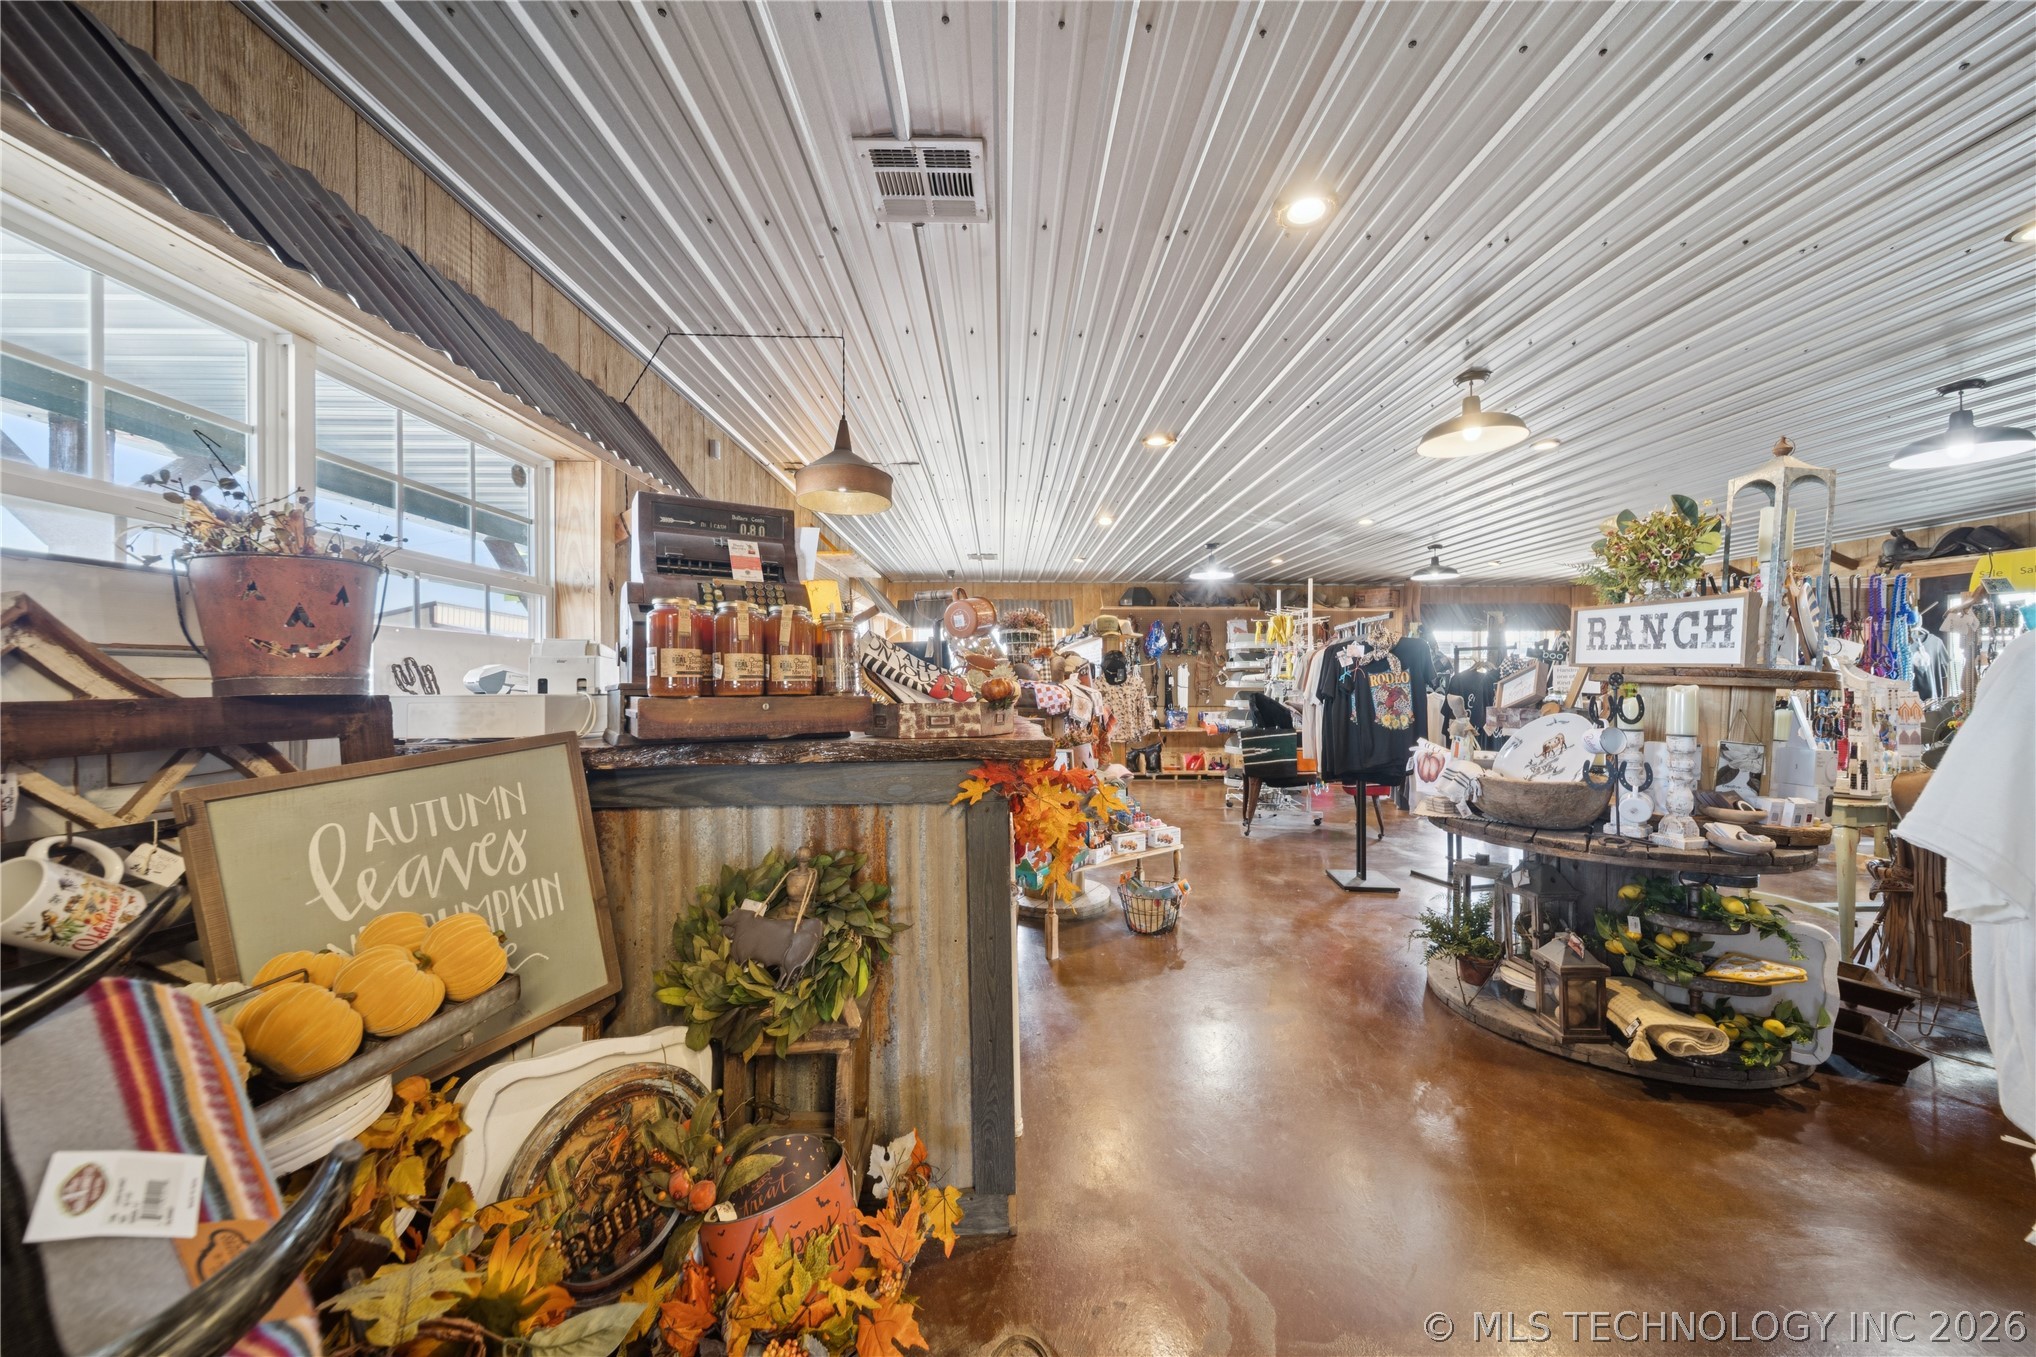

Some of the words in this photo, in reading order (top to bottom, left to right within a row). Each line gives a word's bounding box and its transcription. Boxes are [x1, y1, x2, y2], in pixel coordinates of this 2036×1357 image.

[732, 514, 748, 522] Dollars
[751, 516, 765, 524] Cents
[2020, 565, 2036, 575] Sal
[1586, 608, 1738, 651] RANCH
[895, 653, 931, 682] YOU
[1542, 650, 1564, 660] boo
[365, 782, 528, 853] AUTUMN
[306, 823, 528, 921] leaves
[424, 872, 565, 934] MPKIN
